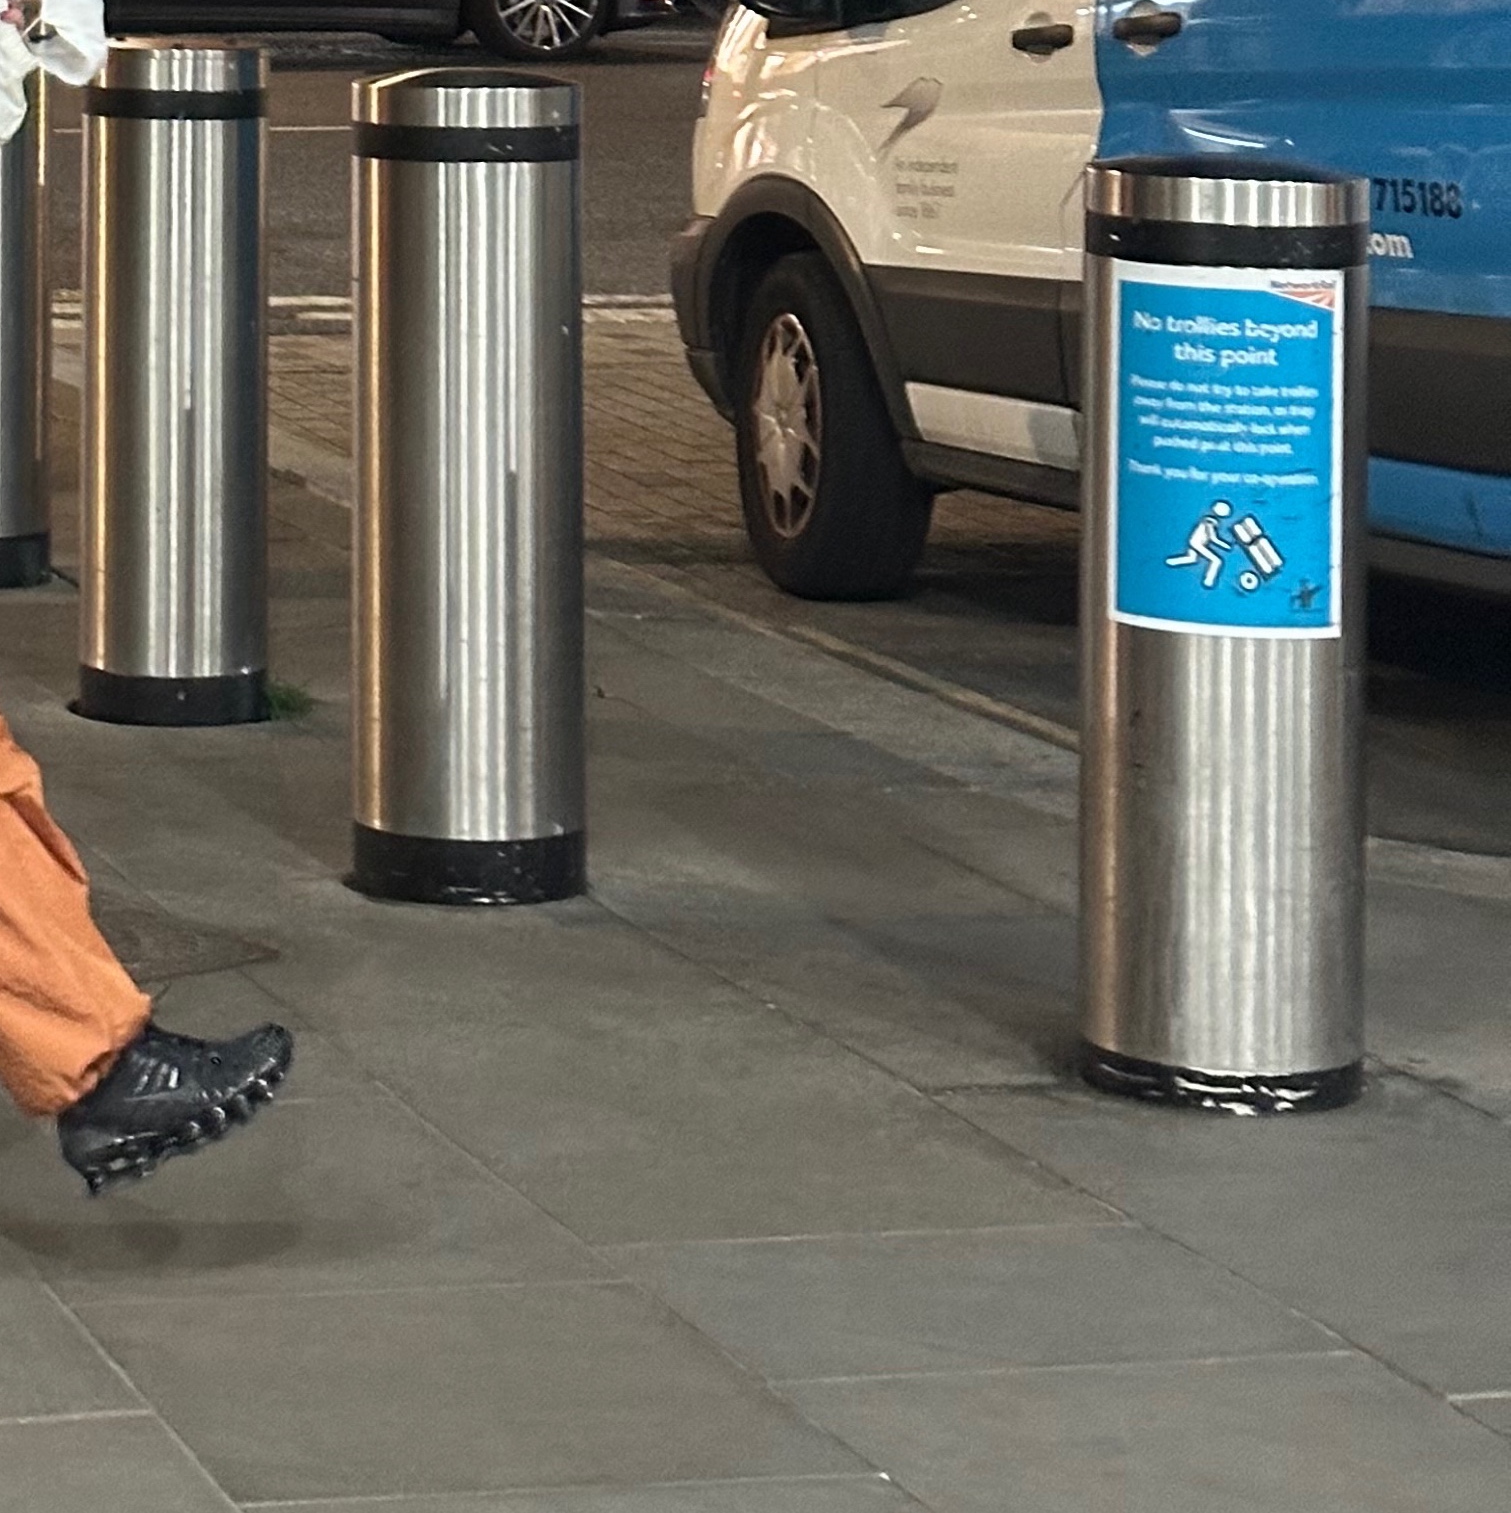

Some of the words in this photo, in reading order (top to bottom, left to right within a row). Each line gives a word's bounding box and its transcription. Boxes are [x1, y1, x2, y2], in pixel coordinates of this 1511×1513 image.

[1133, 310, 1163, 332] No
[1166, 315, 1241, 338] trollies
[1244, 318, 1319, 343] beyond
[1173, 341, 1217, 364] this
[1219, 346, 1279, 368] point
